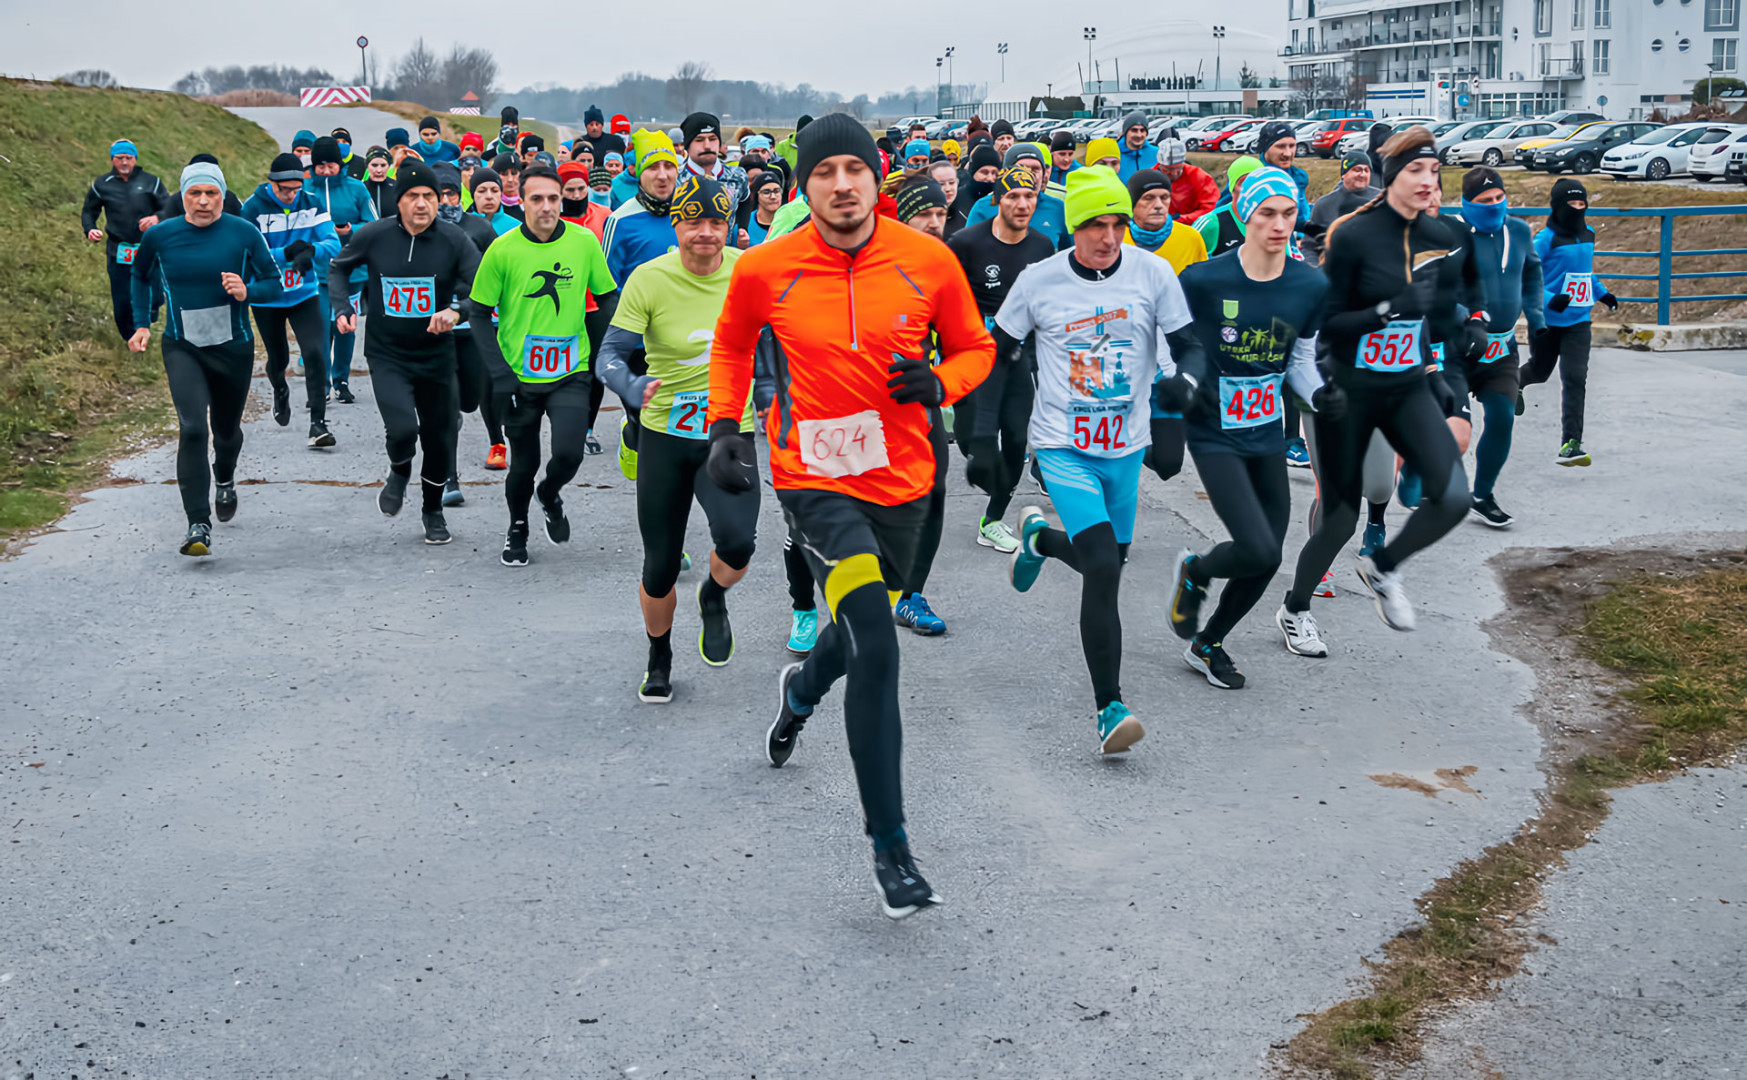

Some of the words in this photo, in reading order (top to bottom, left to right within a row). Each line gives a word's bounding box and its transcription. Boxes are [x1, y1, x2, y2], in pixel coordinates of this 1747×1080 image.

[388, 286, 431, 313] 475
[530, 345, 570, 372] 601
[1364, 332, 1414, 366] 552
[1227, 384, 1275, 422] 426
[813, 424, 867, 461] 624
[1073, 414, 1126, 451] 542
